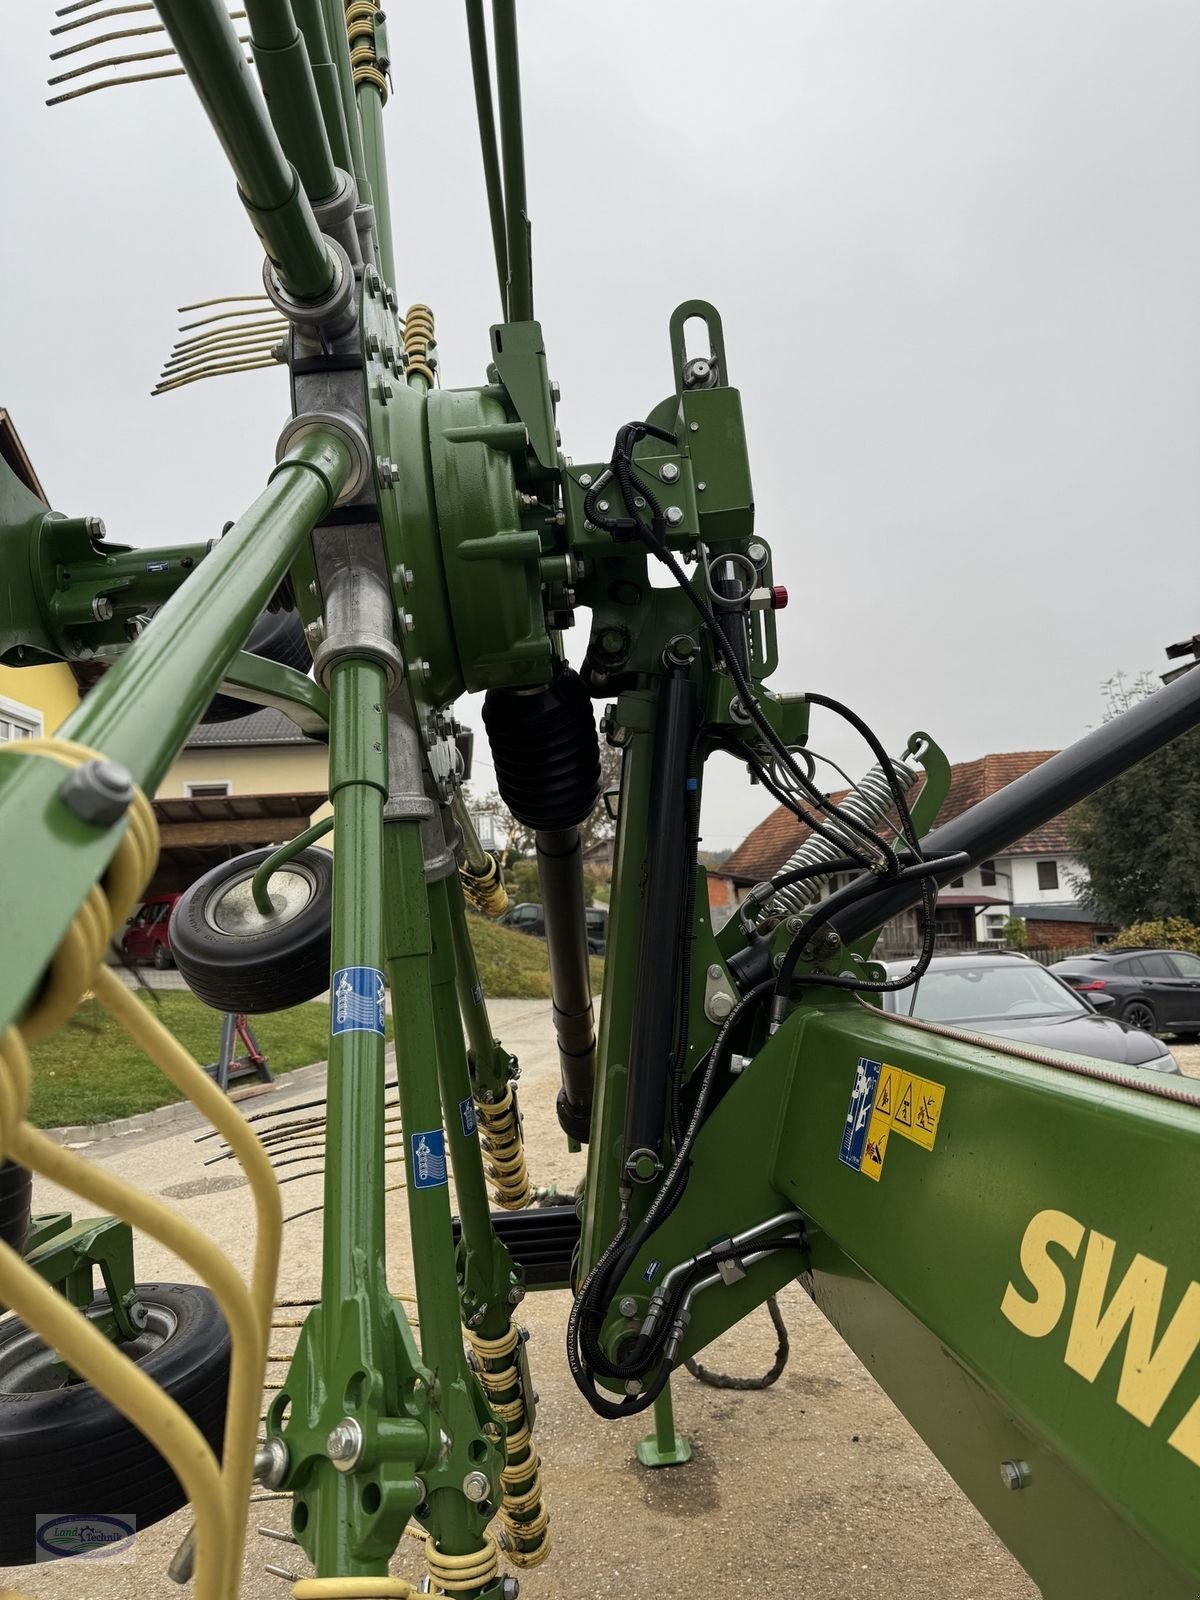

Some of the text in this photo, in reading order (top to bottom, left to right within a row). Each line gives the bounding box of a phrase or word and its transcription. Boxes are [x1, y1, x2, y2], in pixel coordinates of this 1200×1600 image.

[642, 1184, 668, 1224] HYDRAULIK
[664, 1156, 682, 1187] MUELLER
[677, 1135, 691, 1157] RHEINE
[581, 1265, 599, 1290] RHEINE
[569, 1288, 586, 1324] MUELLER
[568, 1324, 579, 1373] HYDRAULIK
[1000, 1209, 1200, 1468] SW
